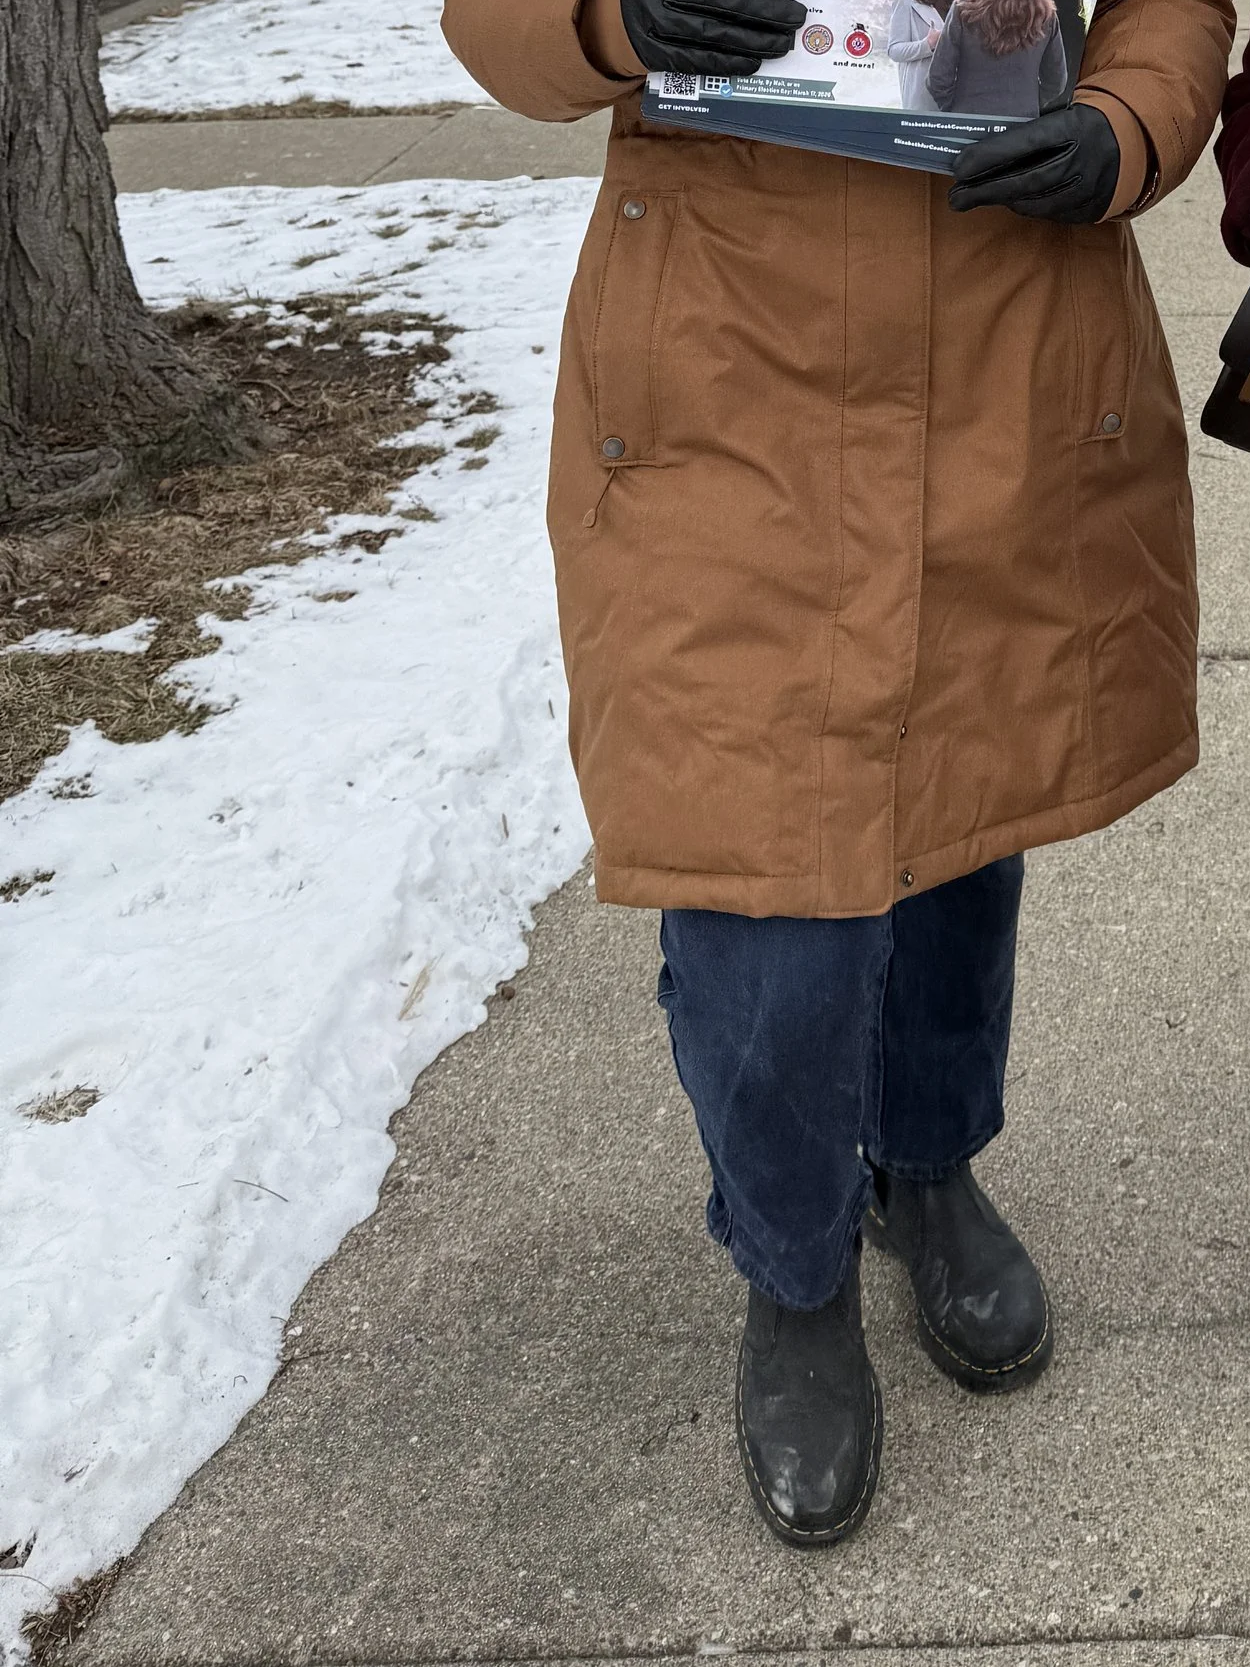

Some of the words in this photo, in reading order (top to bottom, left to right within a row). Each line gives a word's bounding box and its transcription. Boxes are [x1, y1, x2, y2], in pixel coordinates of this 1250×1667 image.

[736, 84, 757, 93] Primary
[758, 86, 780, 94] Election
[658, 103, 671, 111] GET
[672, 105, 710, 114] INVOLVED!
